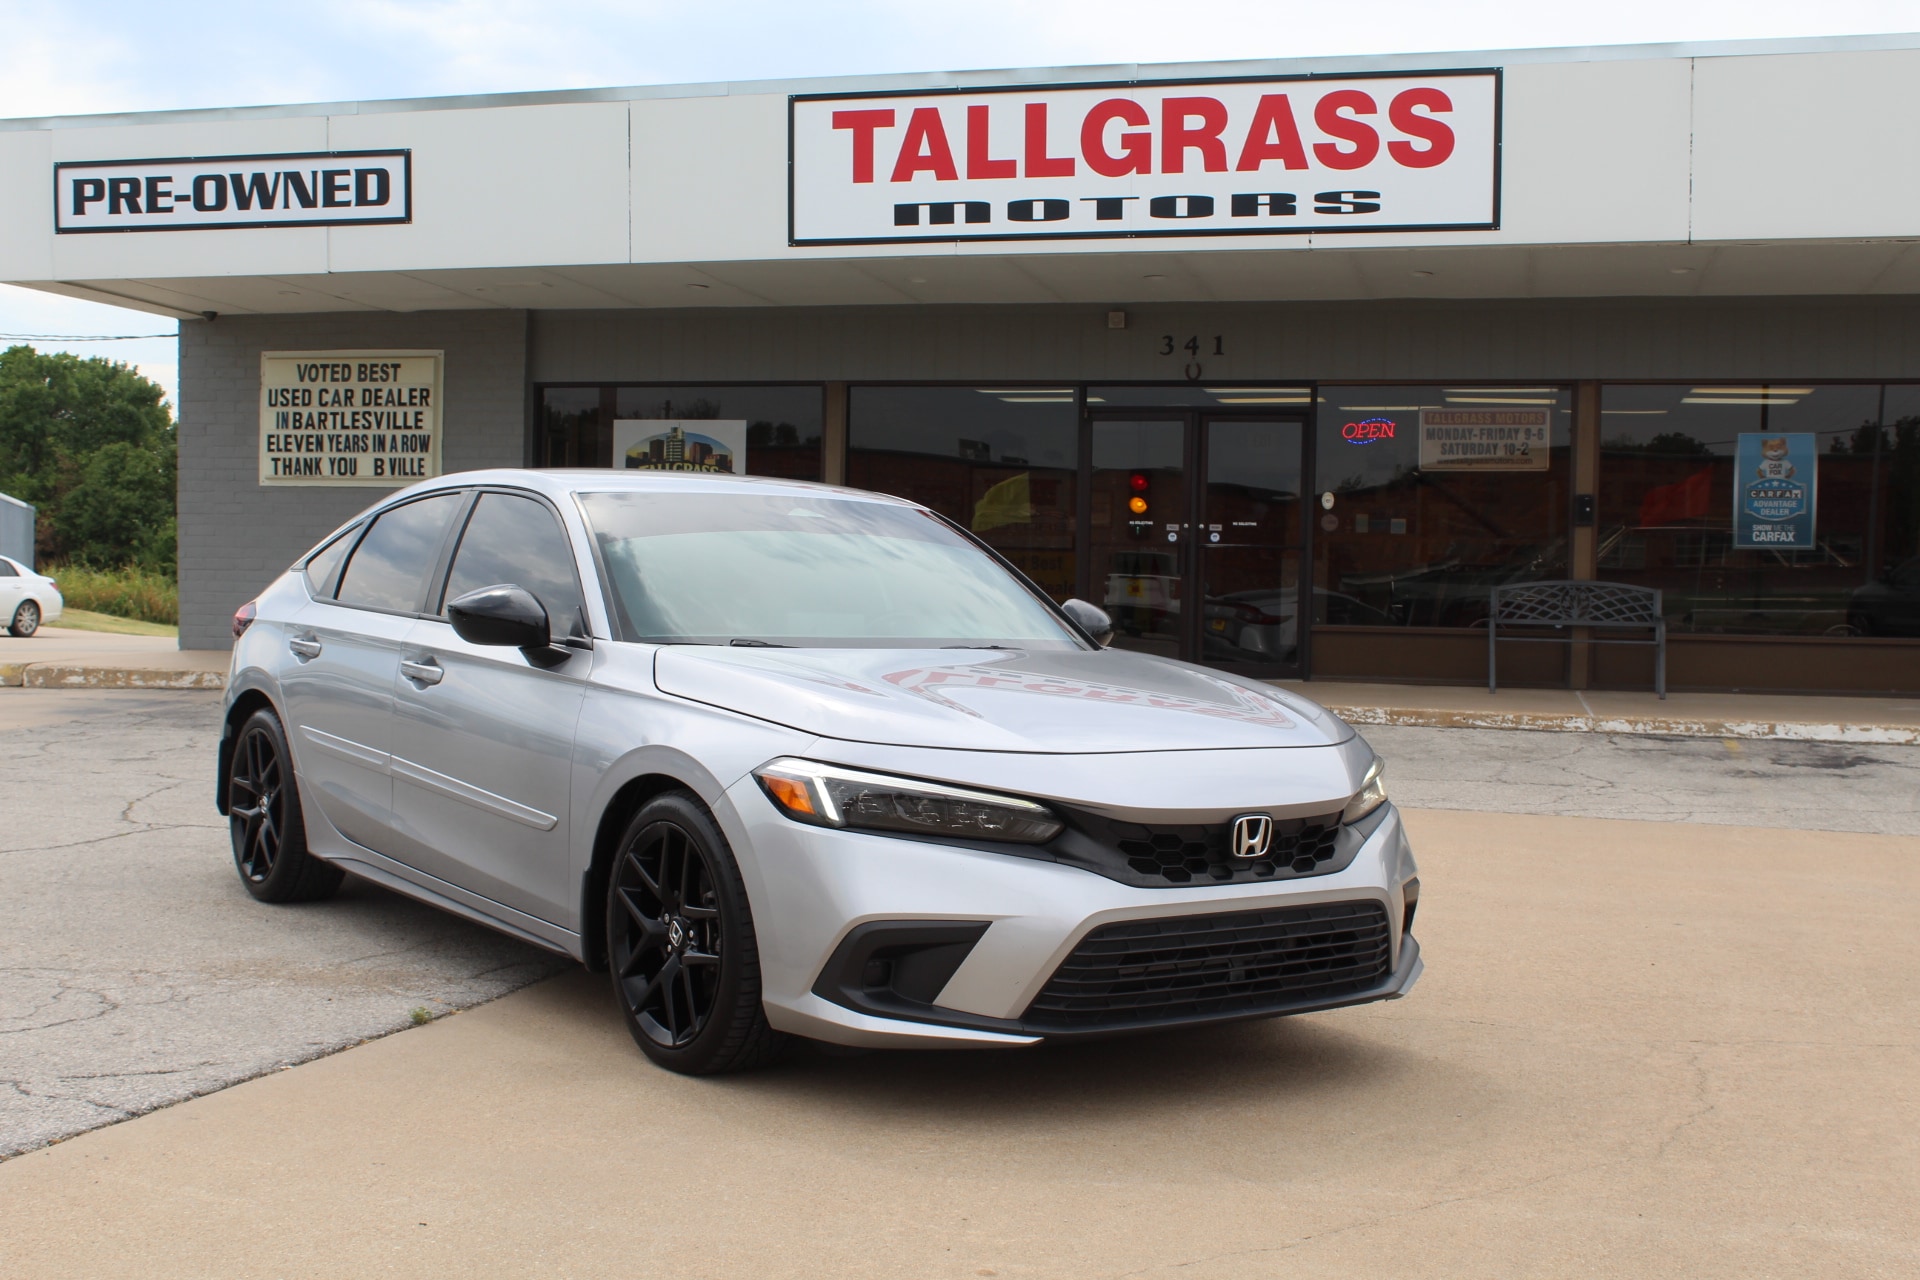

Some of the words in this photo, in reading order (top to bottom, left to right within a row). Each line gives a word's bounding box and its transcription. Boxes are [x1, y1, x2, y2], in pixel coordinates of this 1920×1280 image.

[832, 87, 1456, 184] TALLGRASS
[72, 168, 390, 216] PRE-OWNED
[1159, 335, 1225, 356] 341
[297, 363, 352, 383] VOTED
[357, 363, 402, 383] BEST
[268, 388, 312, 407] USED
[318, 388, 354, 407] CAR
[362, 388, 430, 407] DEALER
[276, 411, 289, 430] IN
[292, 411, 424, 430] BARTLESVILLE
[1427, 412, 1492, 424] TALLGRASS
[1495, 412, 1544, 424] MOTORS
[1341, 422, 1396, 439] OPEN
[1426, 427, 1520, 441] MONDAY-FRIDAY
[1524, 427, 1545, 441] 9-6
[267, 434, 324, 453] ELEVEN
[327, 434, 369, 453] YEARS
[373, 434, 386, 453] IN
[389, 434, 398, 453] A
[401, 434, 431, 453] ROW
[1440, 442, 1499, 456] SATURDAY
[1503, 442, 1529, 456] 10-2
[271, 457, 322, 476] THANK
[328, 457, 357, 476] YOU
[374, 457, 385, 476] B
[389, 457, 425, 476] VILLE
[1750, 490, 1801, 498] CARFAX
[1753, 500, 1798, 508] ADVANTAGE
[1760, 508, 1790, 516] DEALER
[1752, 531, 1795, 542] CARFAX
